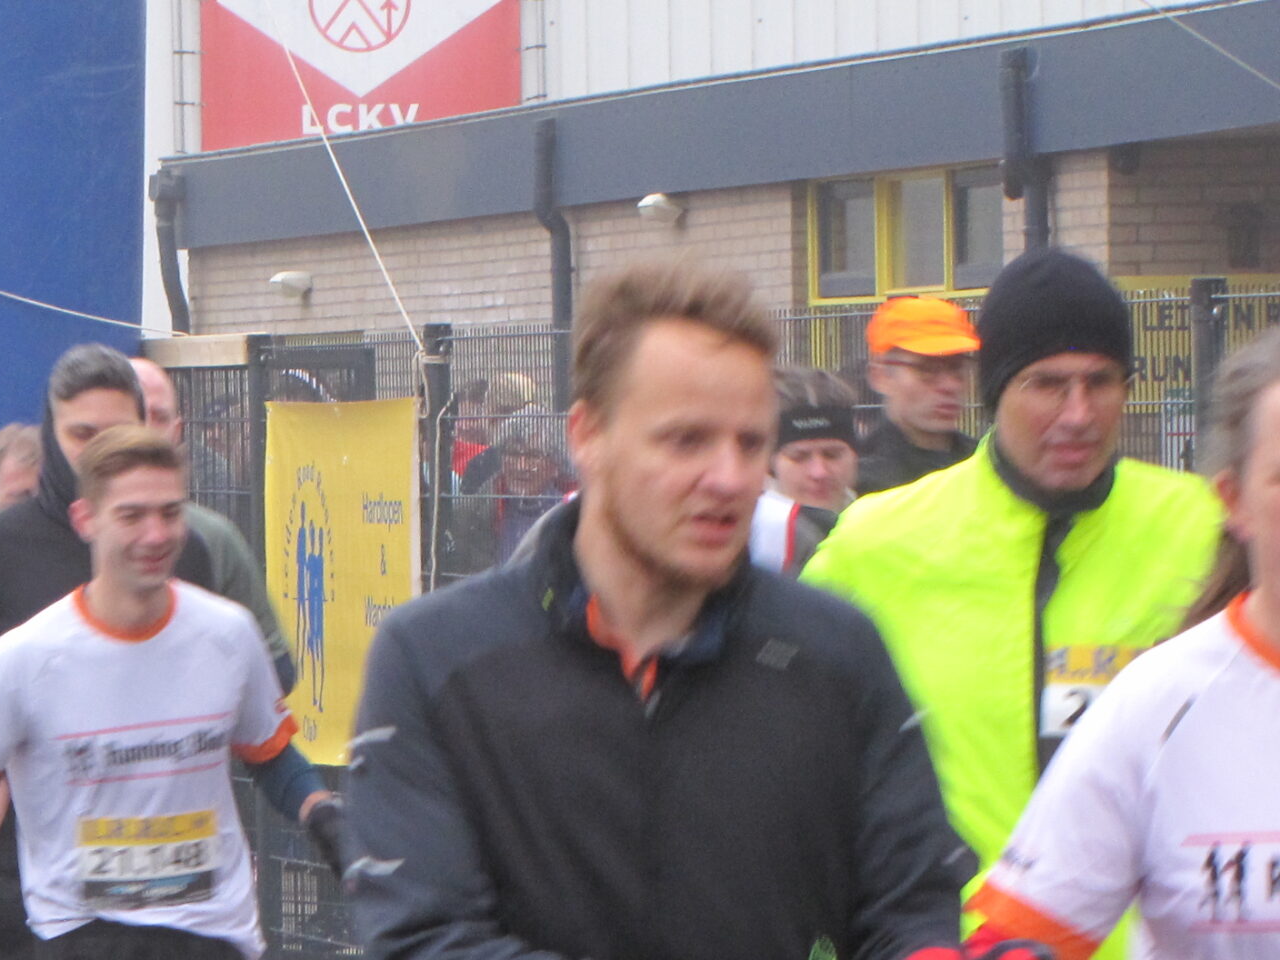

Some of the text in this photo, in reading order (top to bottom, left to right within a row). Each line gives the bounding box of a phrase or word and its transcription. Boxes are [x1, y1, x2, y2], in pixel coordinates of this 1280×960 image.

[302, 103, 419, 134] LCKV
[362, 491, 403, 532] Hardlopen
[380, 543, 387, 576] &
